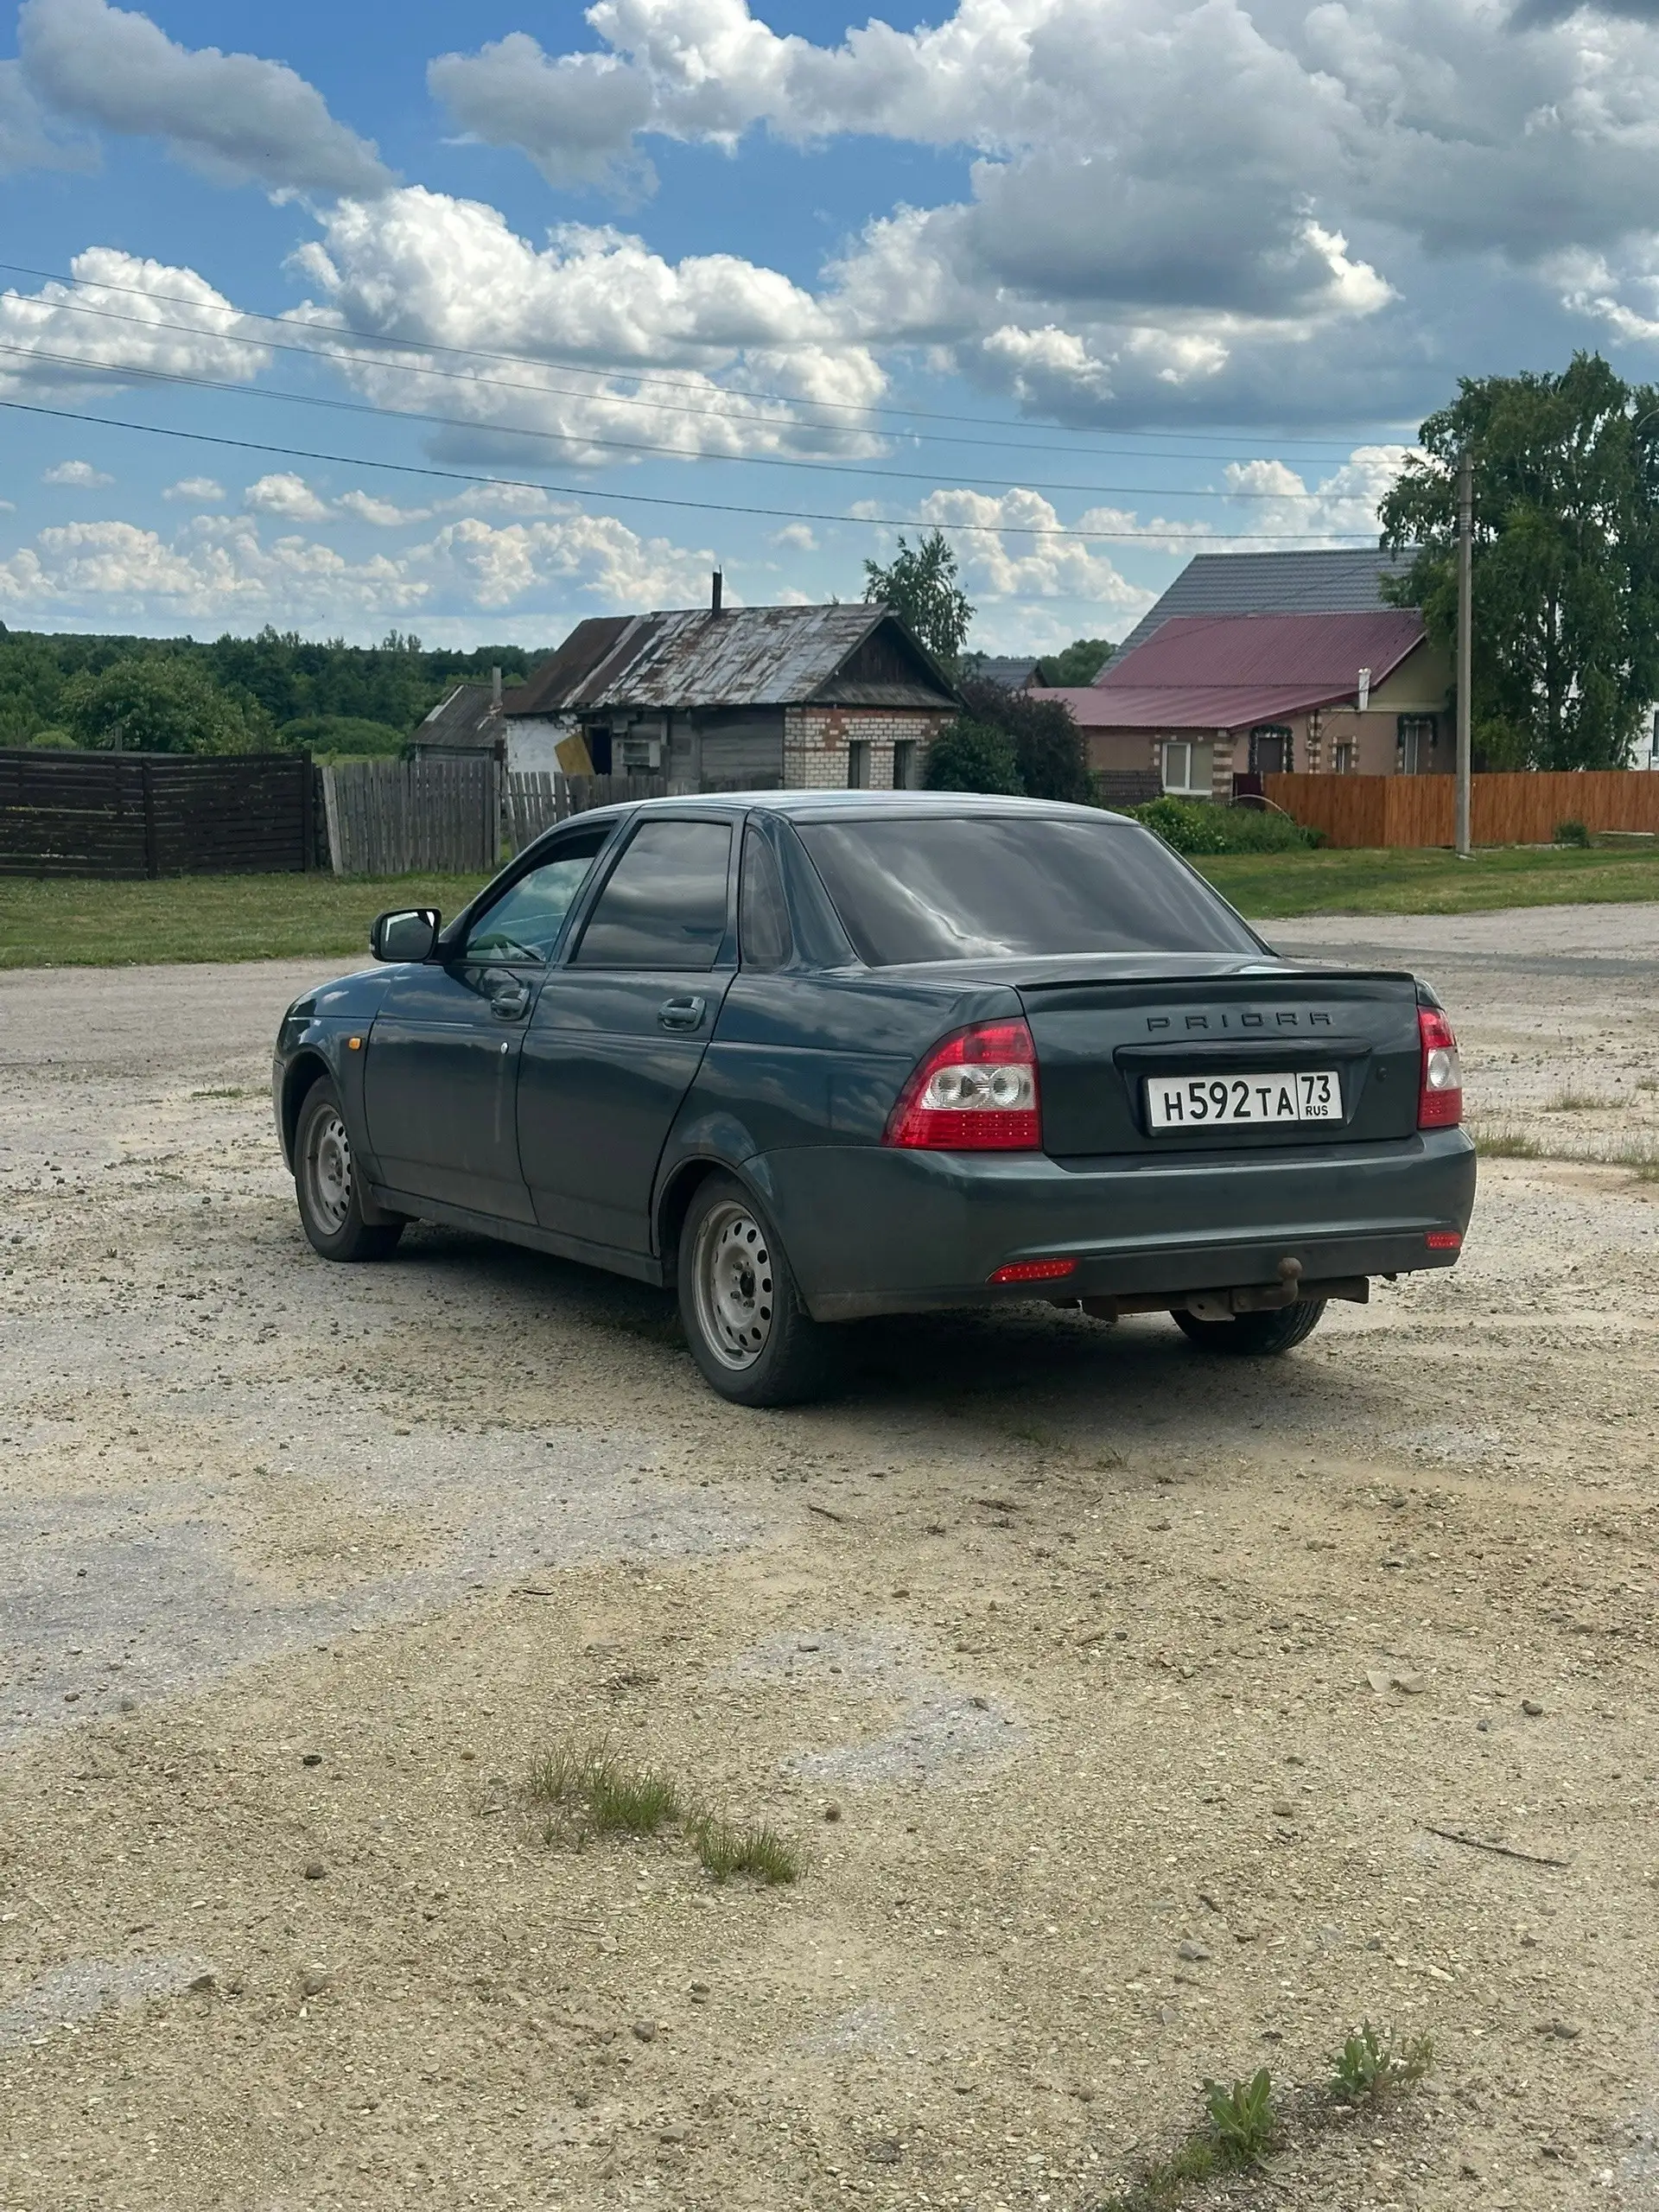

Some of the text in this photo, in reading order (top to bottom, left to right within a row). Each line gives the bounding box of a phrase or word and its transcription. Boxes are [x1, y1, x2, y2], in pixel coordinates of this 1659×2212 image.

[1147, 1012, 1332, 1032] PRIORA
[1300, 1075, 1332, 1104] 73
[1306, 1105, 1328, 1116] RUS
